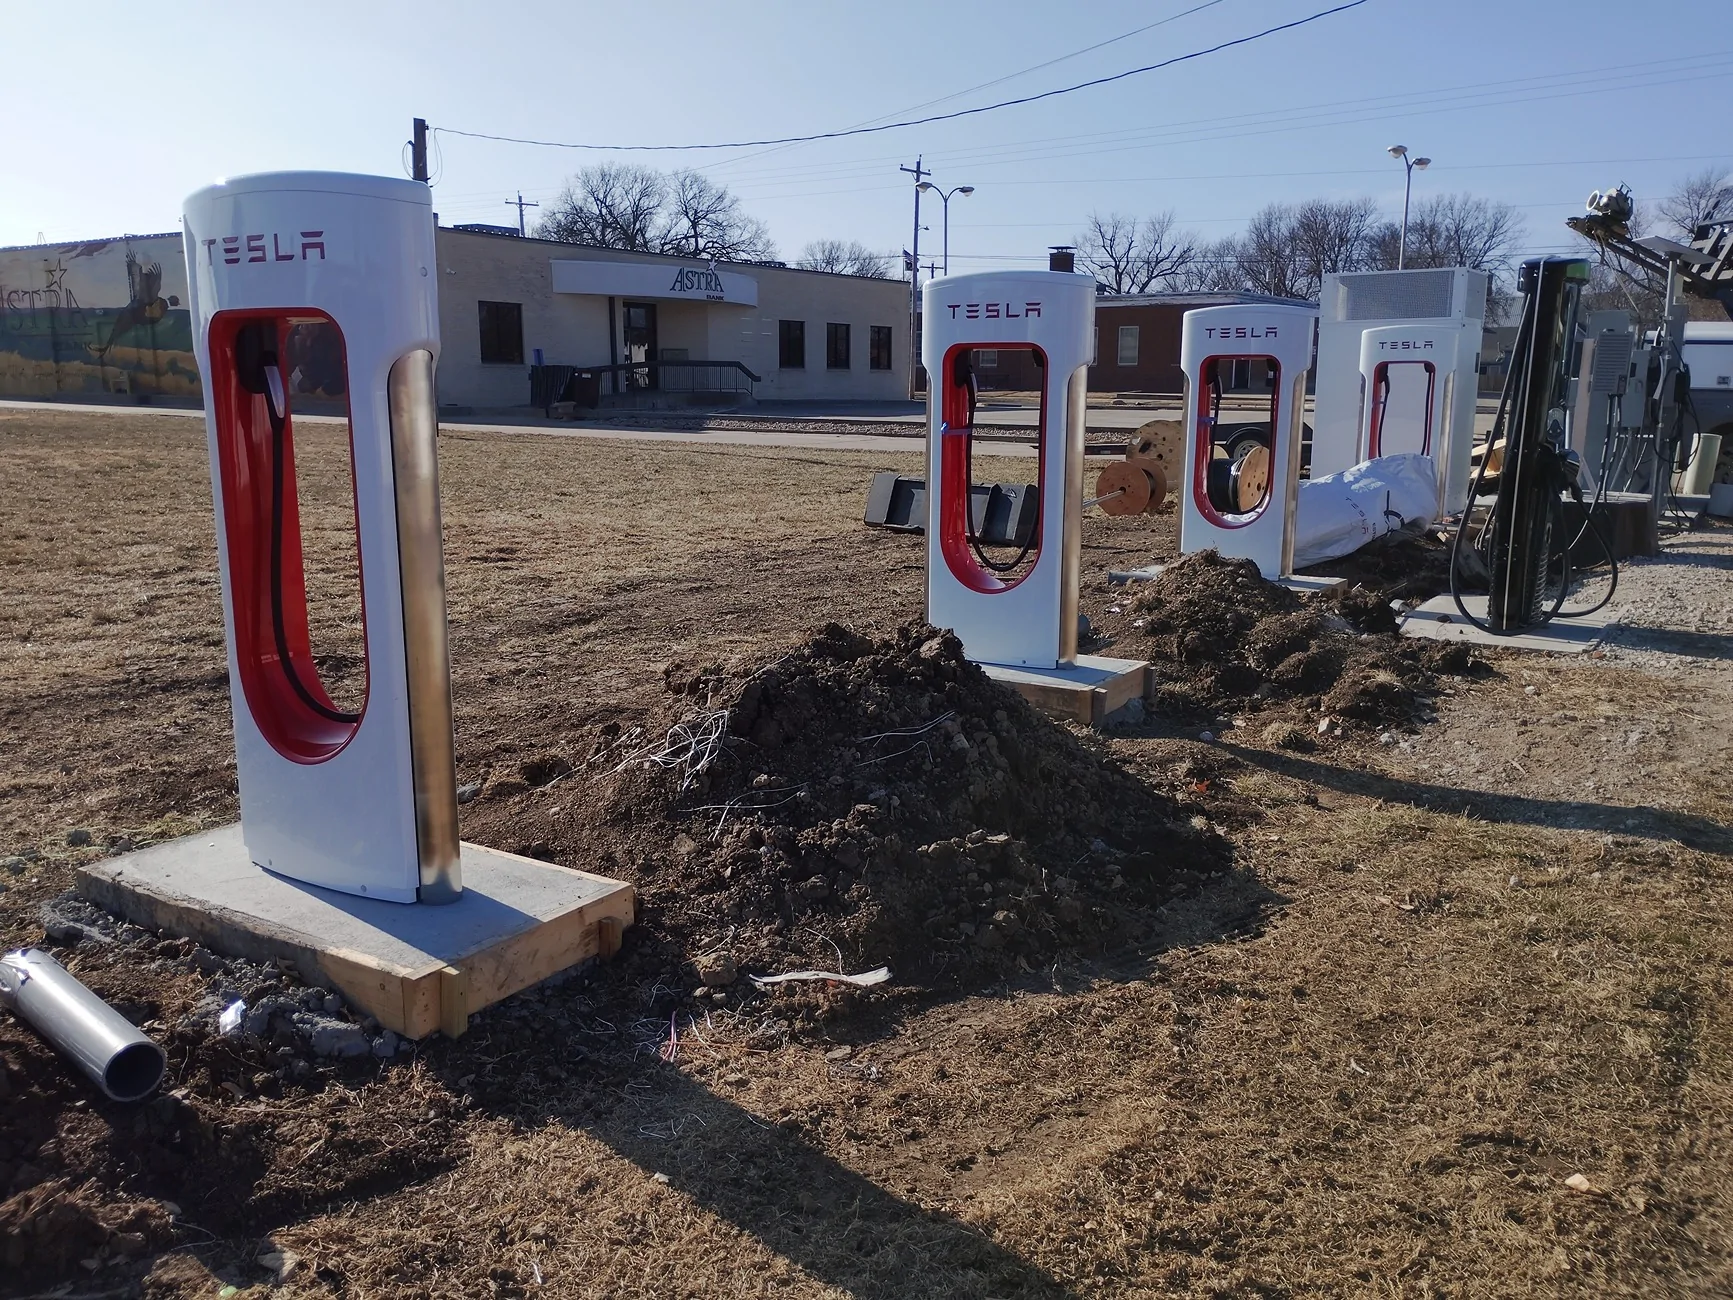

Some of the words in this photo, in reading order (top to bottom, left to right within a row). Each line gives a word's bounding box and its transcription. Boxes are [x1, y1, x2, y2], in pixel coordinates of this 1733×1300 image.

[201, 231, 325, 265] TESLA
[669, 267, 724, 293] ASTRA
[947, 302, 1042, 319] TESLA
[1205, 327, 1278, 339] TESLA
[1379, 340, 1434, 350] TESLA
